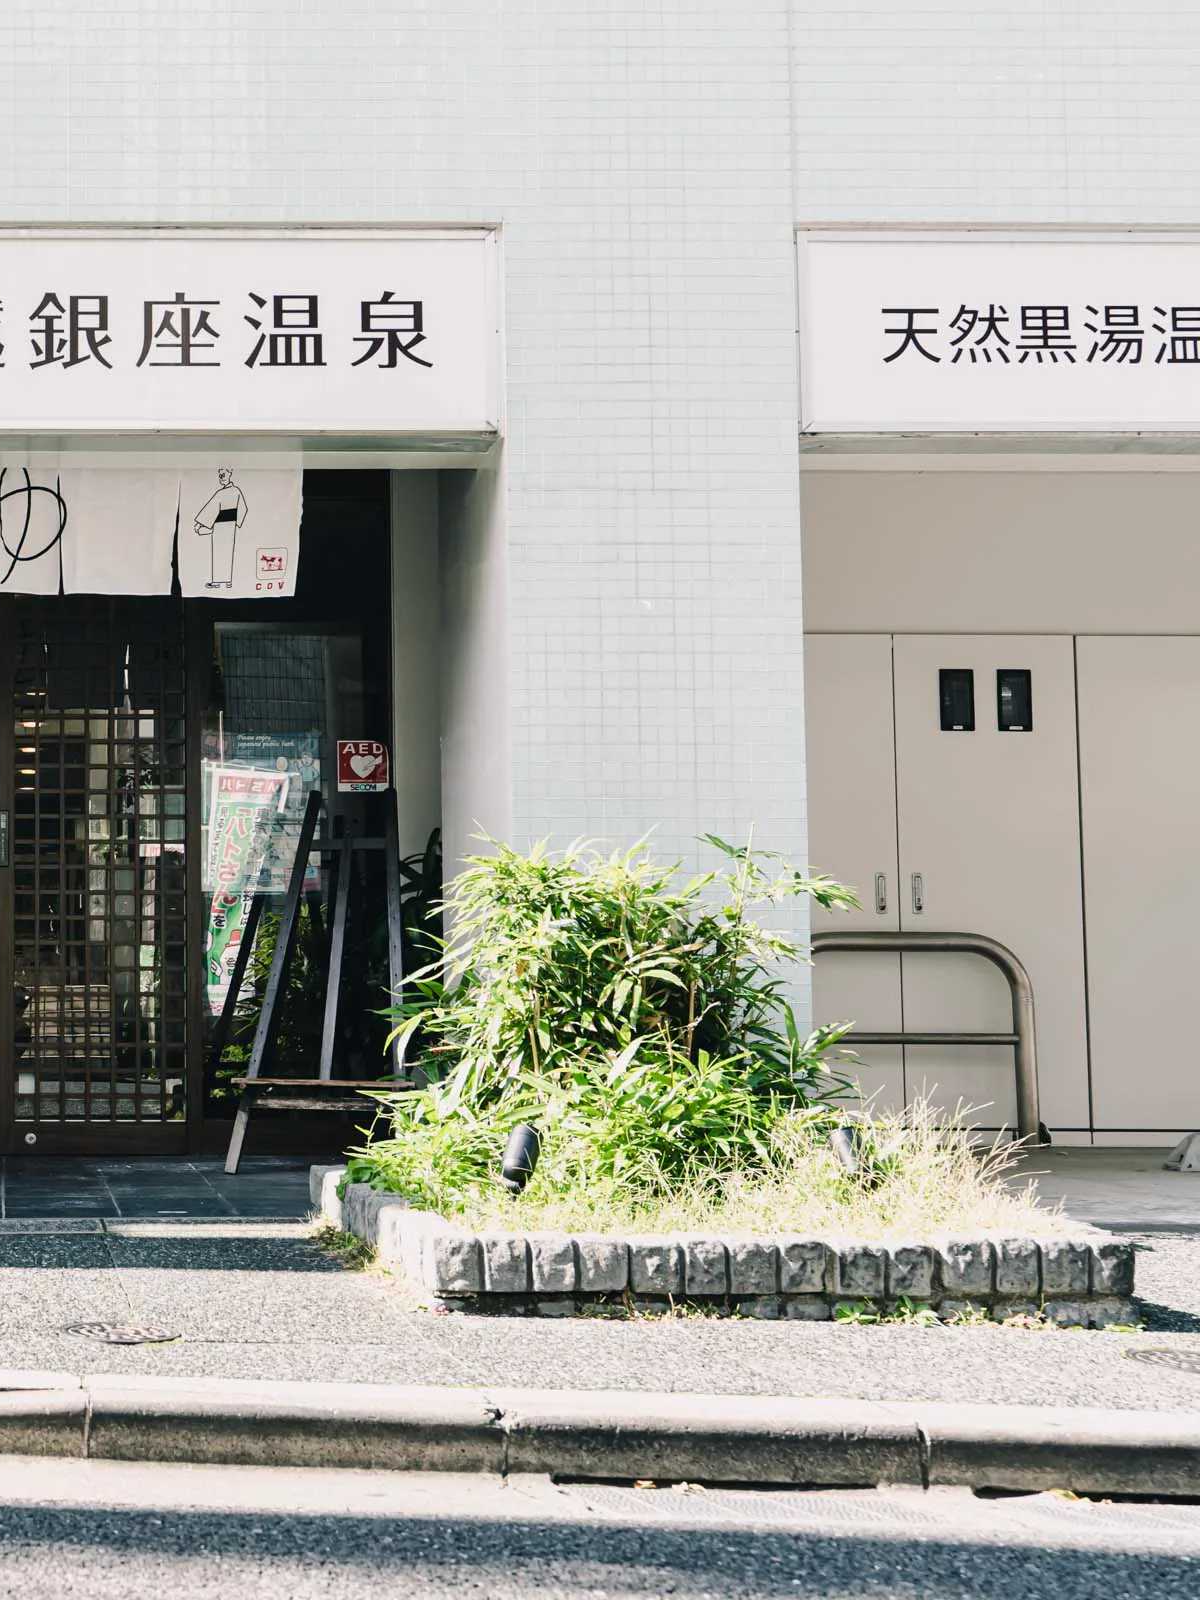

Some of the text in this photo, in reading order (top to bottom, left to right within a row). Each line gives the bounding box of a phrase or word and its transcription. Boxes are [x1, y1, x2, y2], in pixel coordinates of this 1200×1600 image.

[880, 303, 1200, 365] 天然黒湯温
[342, 743, 384, 754] AED
